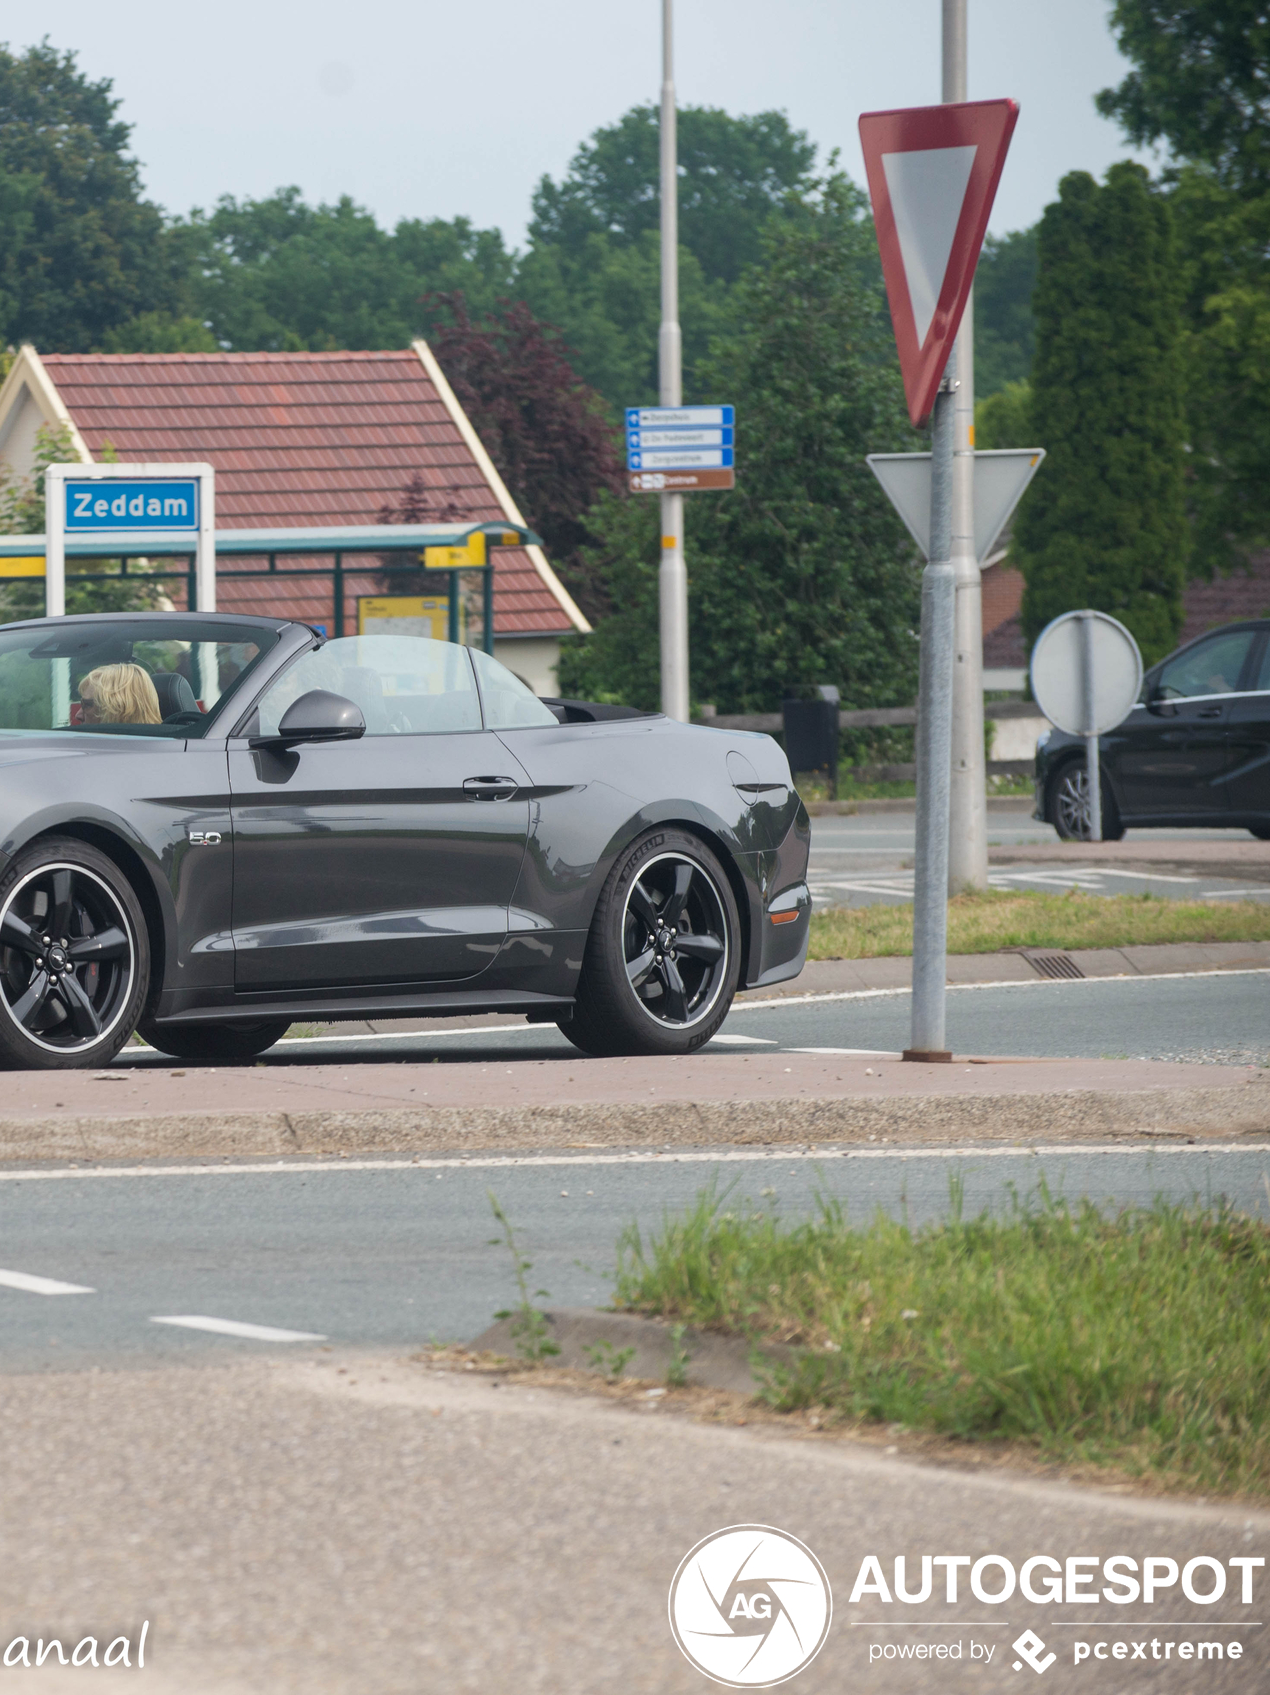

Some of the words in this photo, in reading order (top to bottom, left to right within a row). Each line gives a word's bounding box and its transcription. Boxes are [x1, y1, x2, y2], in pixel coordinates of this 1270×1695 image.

[73, 492, 188, 518] Zeddam
[189, 831, 222, 846] 5.0
[622, 833, 665, 883] MICHELIN
